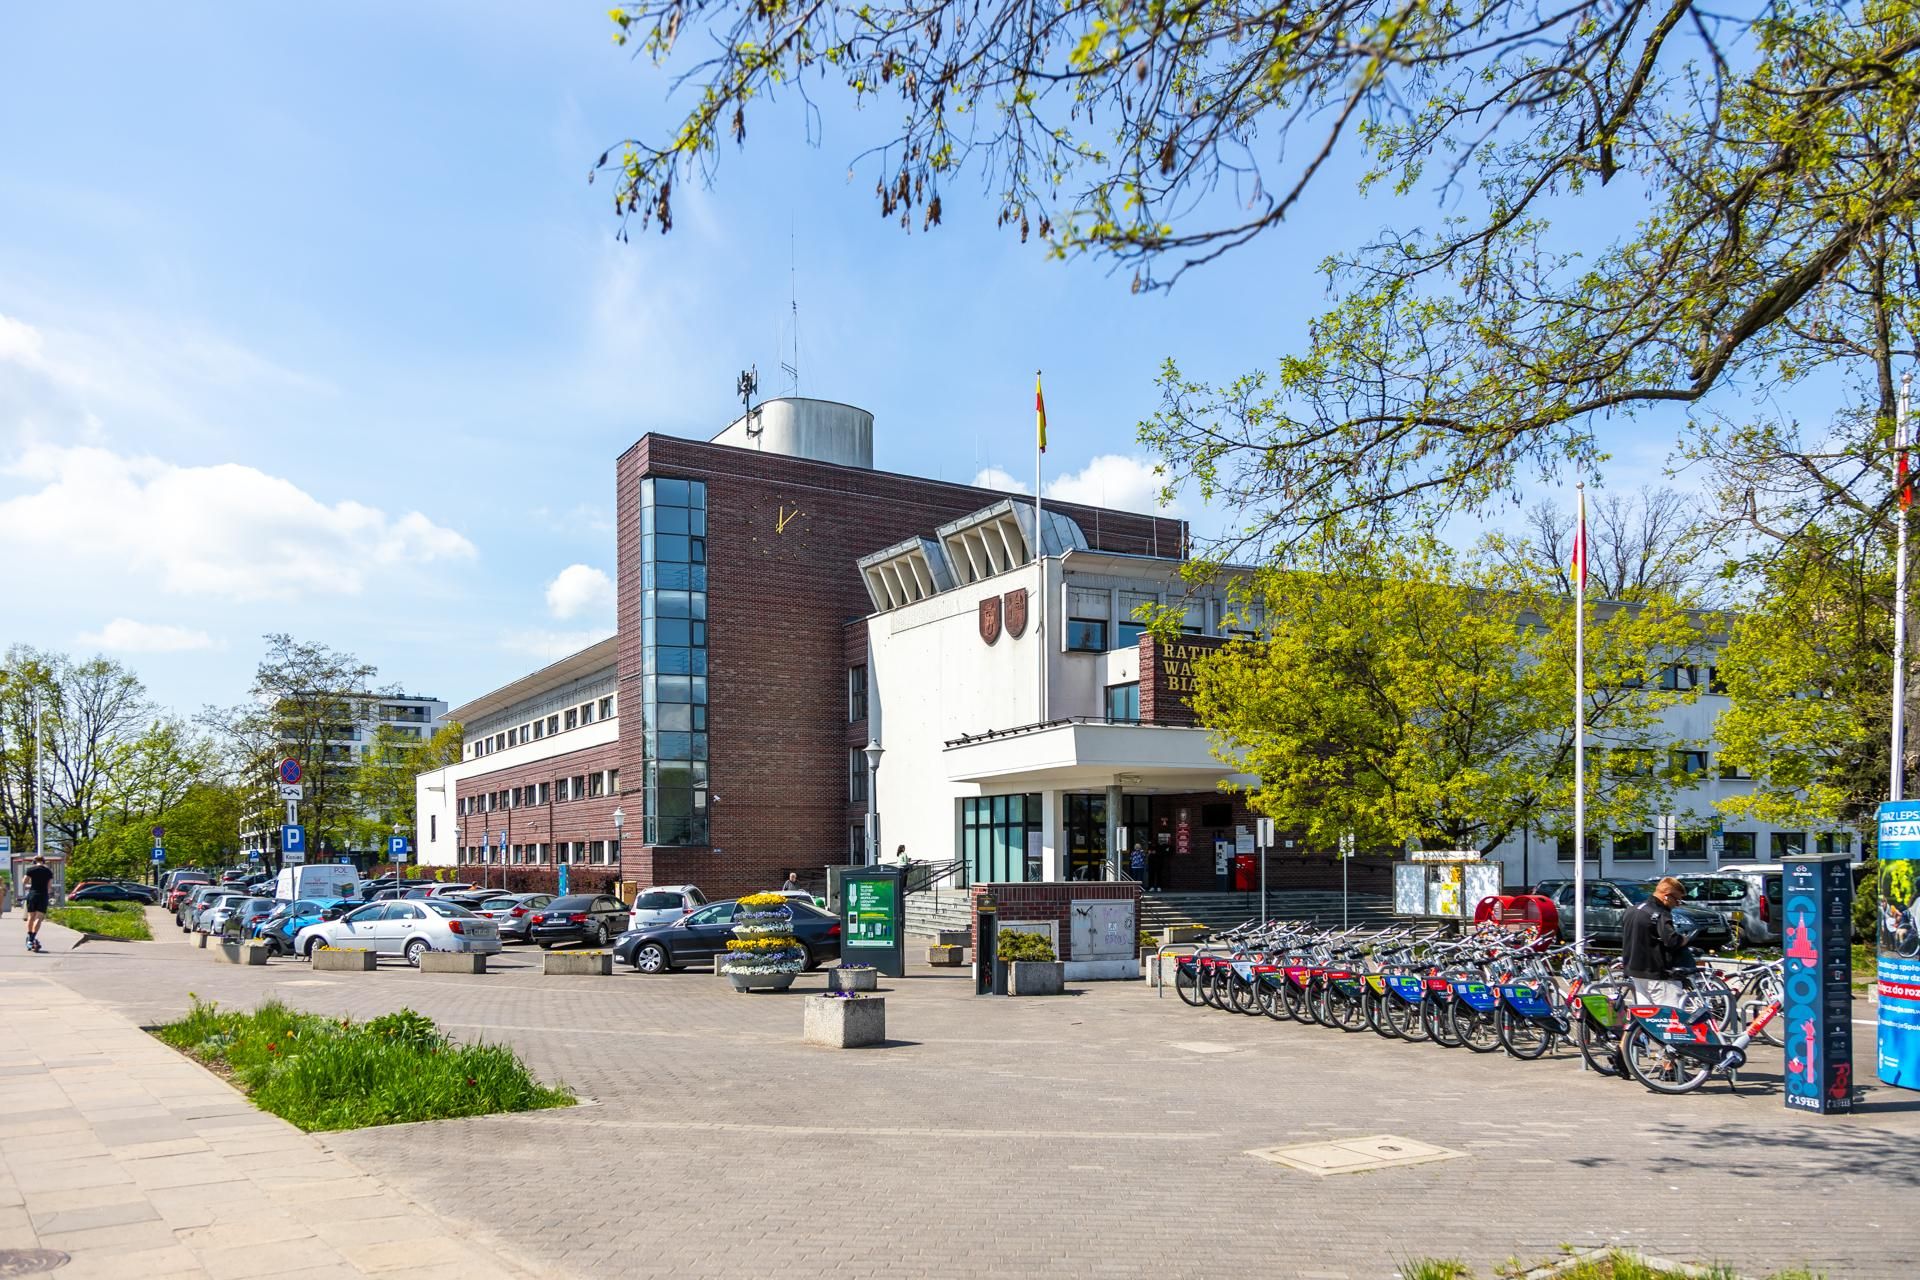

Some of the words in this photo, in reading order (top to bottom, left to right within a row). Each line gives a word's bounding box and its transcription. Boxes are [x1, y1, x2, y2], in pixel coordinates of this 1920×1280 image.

[1163, 676, 1199, 691] -BIA
[287, 828, 300, 849] P
[392, 838, 403, 852] P
[154, 849, 163, 858] P
[1892, 984, 1904, 995] do
[1795, 1096, 1820, 1109] 19115
